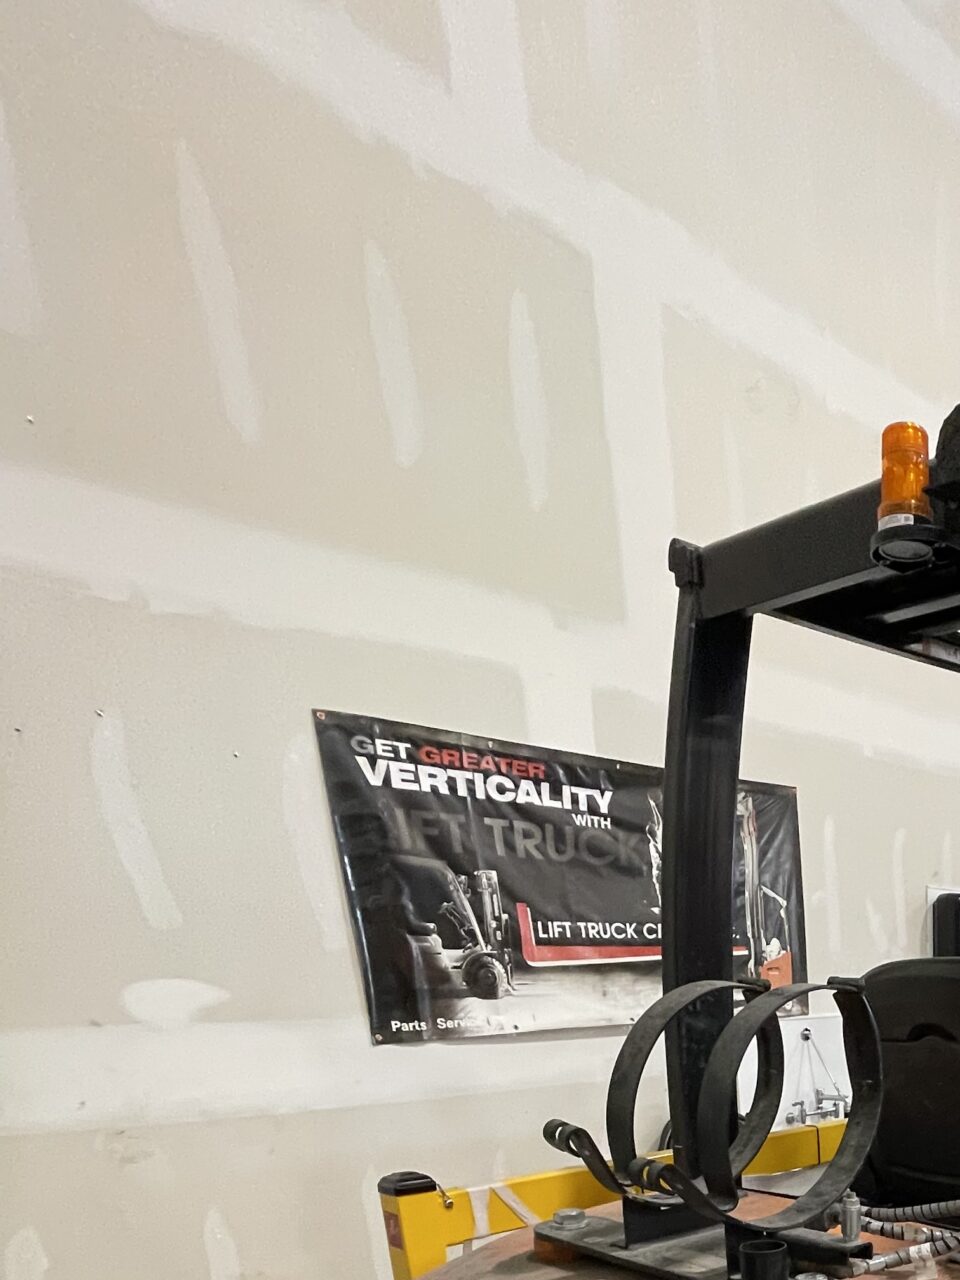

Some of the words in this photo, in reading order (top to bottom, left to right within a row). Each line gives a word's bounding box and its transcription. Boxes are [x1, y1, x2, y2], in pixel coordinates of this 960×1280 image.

[350, 735, 411, 760] GET
[418, 745, 545, 779] GREATER
[354, 755, 613, 814] VERTICALITY
[571, 813, 612, 830] WITH
[484, 816, 643, 866] TRUCK
[537, 921, 572, 938] LIFT
[577, 922, 638, 939] TRUCK
[391, 1020, 427, 1032] Parts
